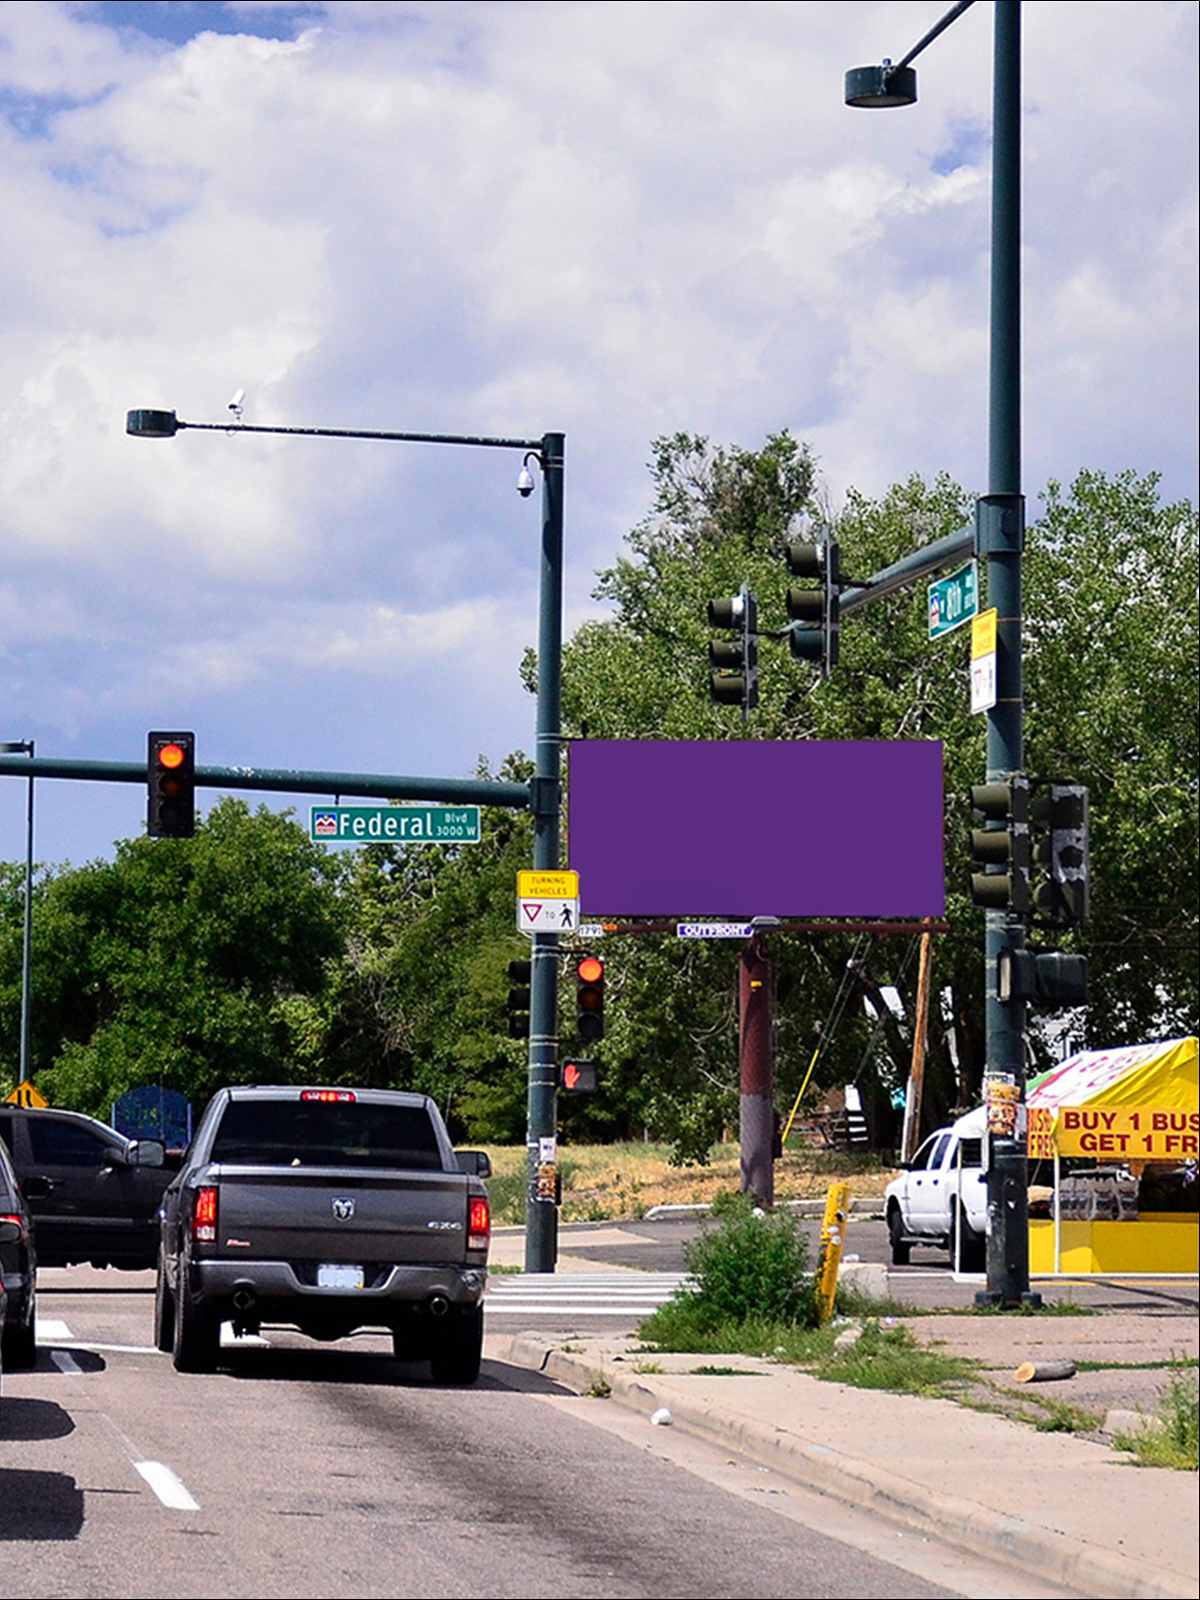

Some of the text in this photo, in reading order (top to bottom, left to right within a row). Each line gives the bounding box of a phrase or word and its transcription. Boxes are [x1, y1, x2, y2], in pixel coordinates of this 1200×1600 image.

[444, 813, 468, 823] Blvd
[339, 812, 433, 837] Federal
[436, 826, 476, 836] 3000 W
[531, 876, 565, 884] TURNING
[529, 887, 567, 895] VEHICLES
[545, 911, 556, 919] TO
[684, 924, 745, 936] OUTFRONT
[1065, 1112, 1199, 1132] BUY 1 BUS
[1080, 1133, 1198, 1153] GET 1 FR
